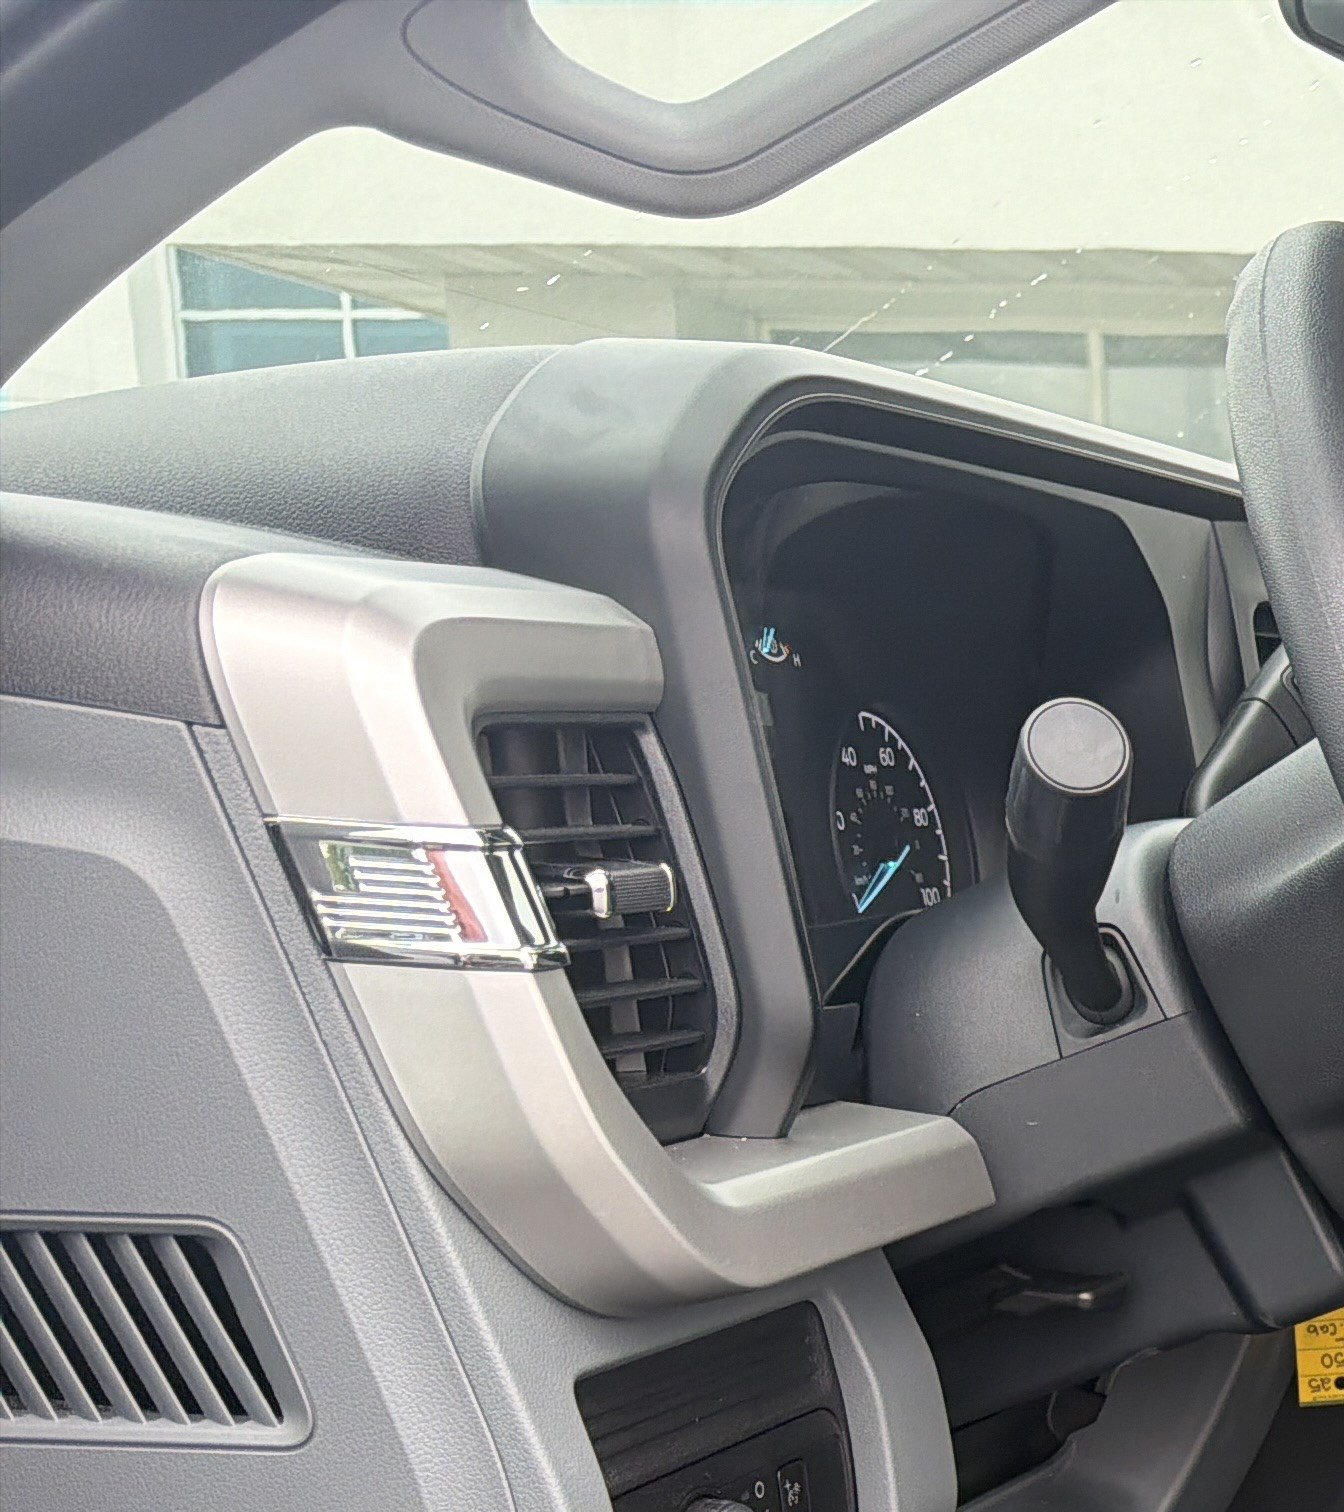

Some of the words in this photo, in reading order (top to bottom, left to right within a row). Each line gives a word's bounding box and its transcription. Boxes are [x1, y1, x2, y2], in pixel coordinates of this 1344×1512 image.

[792, 652, 802, 668] H
[841, 746, 857, 767] 40
[879, 746, 895, 767] 60
[912, 807, 928, 827] 80
[920, 886, 941, 907] 100
[1306, 1322, 1337, 1336] Cab
[1307, 1377, 1331, 1393] 25
